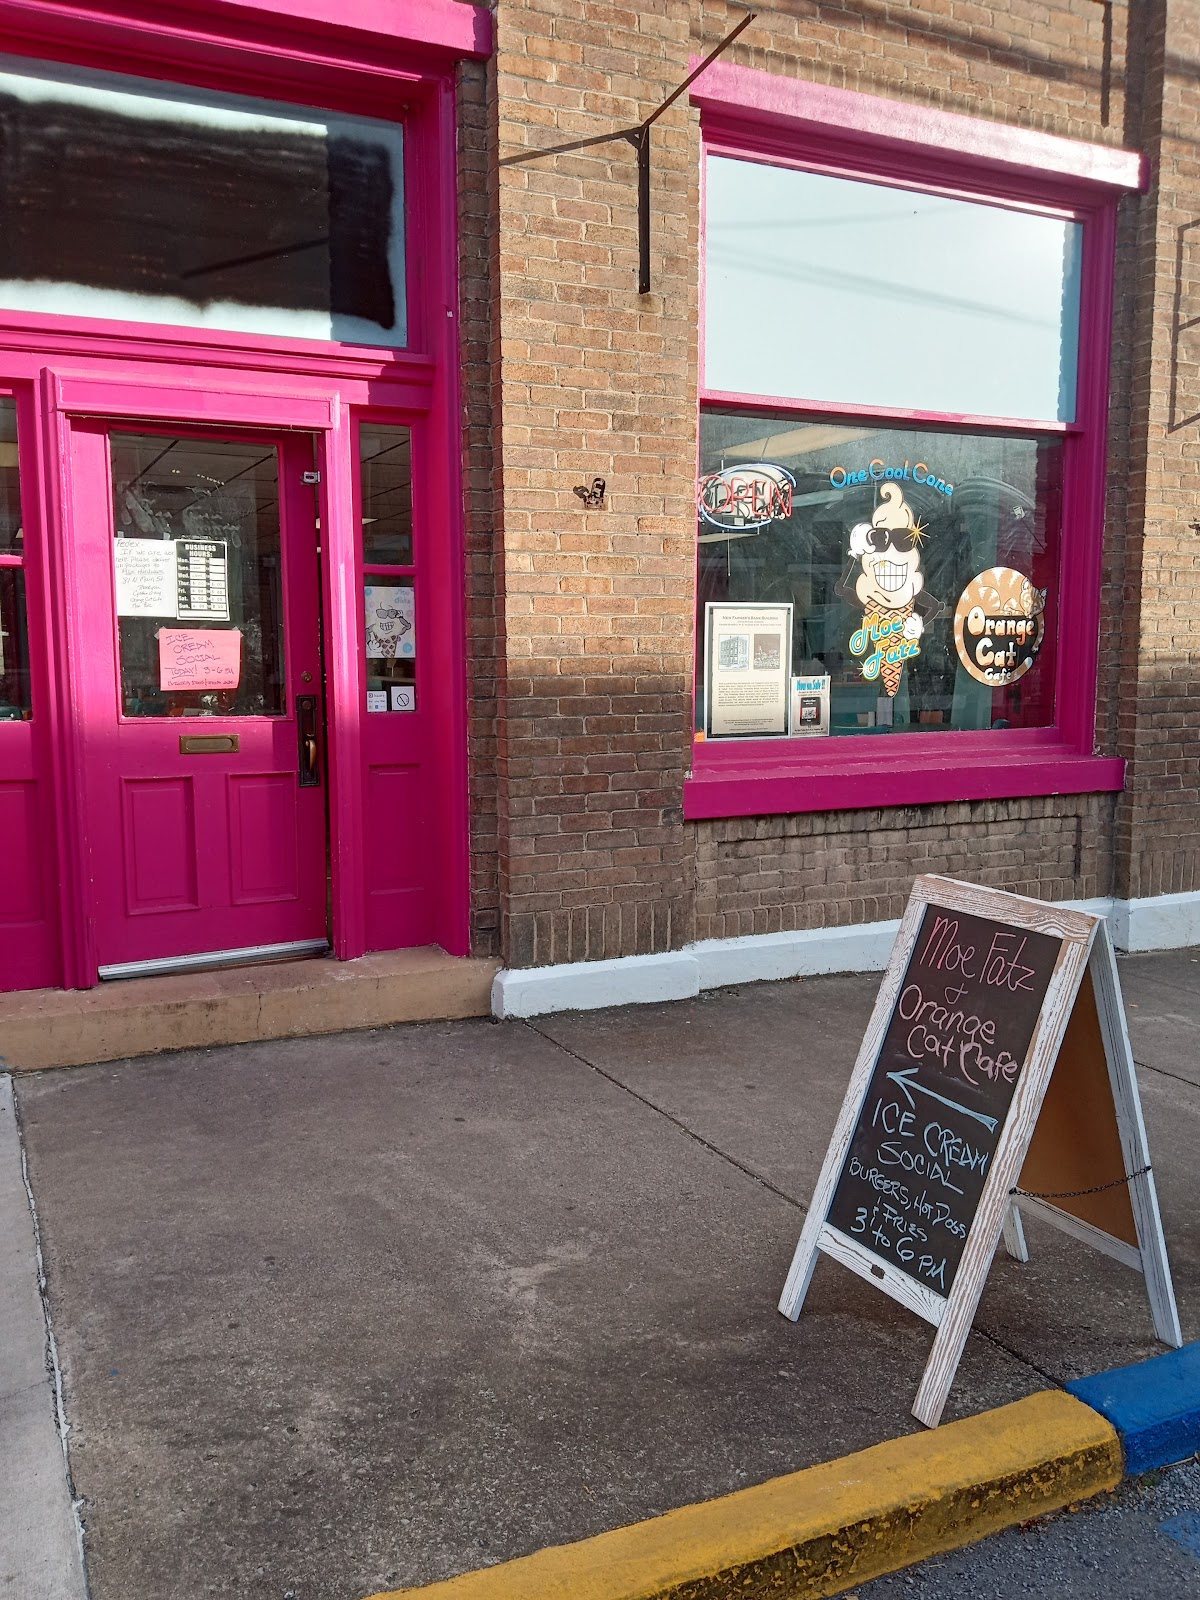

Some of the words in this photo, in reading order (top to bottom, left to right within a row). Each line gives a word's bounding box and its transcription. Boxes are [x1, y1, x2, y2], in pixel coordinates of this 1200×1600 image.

[700, 474, 792, 517] OPEN
[830, 466, 867, 488] One
[869, 458, 910, 480] Cool
[912, 462, 954, 496] Cone
[166, 633, 194, 645] ICE
[849, 612, 904, 656] Moe
[967, 605, 1035, 645] Orange
[173, 639, 214, 654] CREAM
[175, 654, 220, 666] SOCIAL
[863, 638, 921, 680] Fatz
[975, 637, 1017, 667] Cat
[164, 664, 198, 676] TODAY!
[796, 680, 806, 690] Now
[920, 916, 975, 978] Moe
[979, 932, 1035, 991] Fatz
[899, 984, 996, 1045] Orange
[907, 1024, 955, 1068] Cat
[960, 1040, 1018, 1086] Cafe
[872, 1098, 916, 1137] ICE
[923, 1122, 989, 1175] CREAM
[877, 1141, 964, 1195] SOCIAL
[883, 1203, 928, 1242] FRIES
[851, 1207, 868, 1232] 3
[872, 1225, 891, 1247] to
[896, 1237, 914, 1261] 6
[918, 1255, 947, 1289] PM
